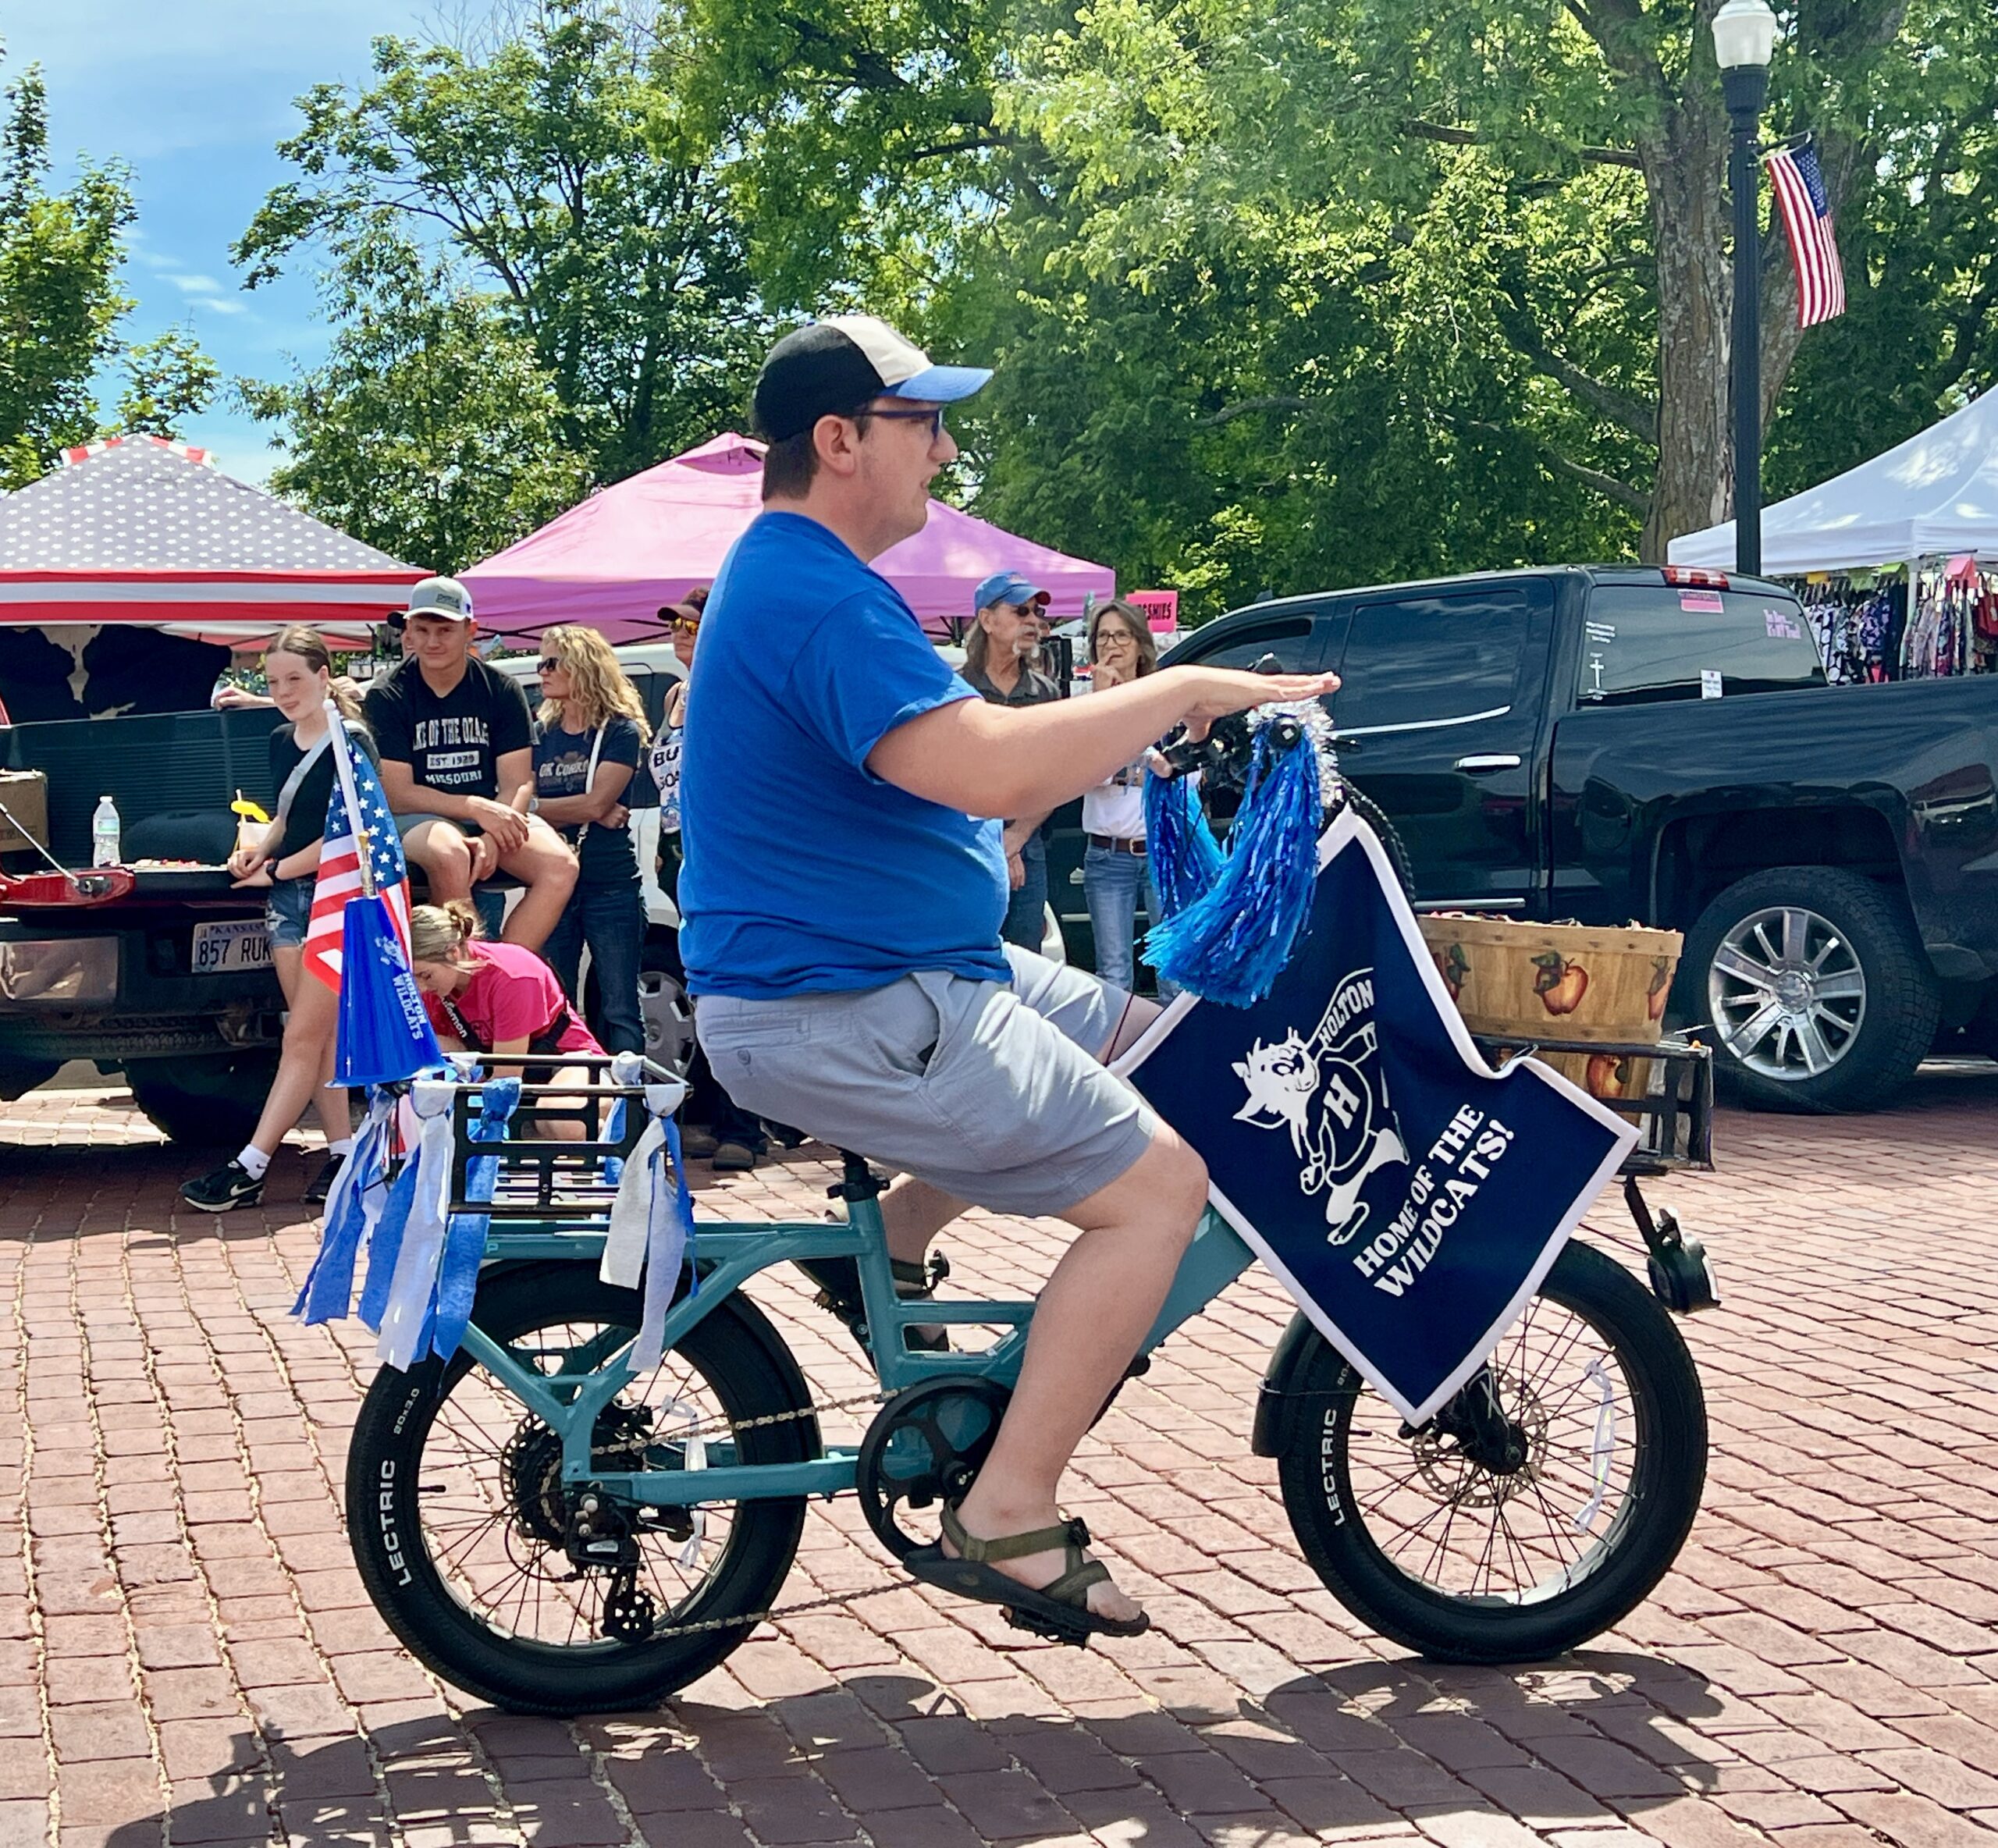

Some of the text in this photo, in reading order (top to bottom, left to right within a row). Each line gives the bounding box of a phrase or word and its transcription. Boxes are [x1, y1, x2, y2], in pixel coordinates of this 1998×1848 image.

[428, 720, 439, 747] OF
[442, 718, 460, 745] THE
[654, 746, 680, 769] BU
[425, 769, 482, 785] MISSOURI
[198, 938, 232, 967] 857
[215, 923, 261, 935] KANSAS
[393, 974, 424, 1040] WILDCATS
[402, 972, 427, 1025] HOLTON
[1317, 979, 1374, 1048] HOLTON
[1323, 1073, 1360, 1129] H
[1353, 1103, 1484, 1278] HOME OF THE
[1374, 1119, 1514, 1298] WILDCATS!
[1321, 1408, 1346, 1526] LECTRIC
[379, 1459, 413, 1587] LECTRIC
